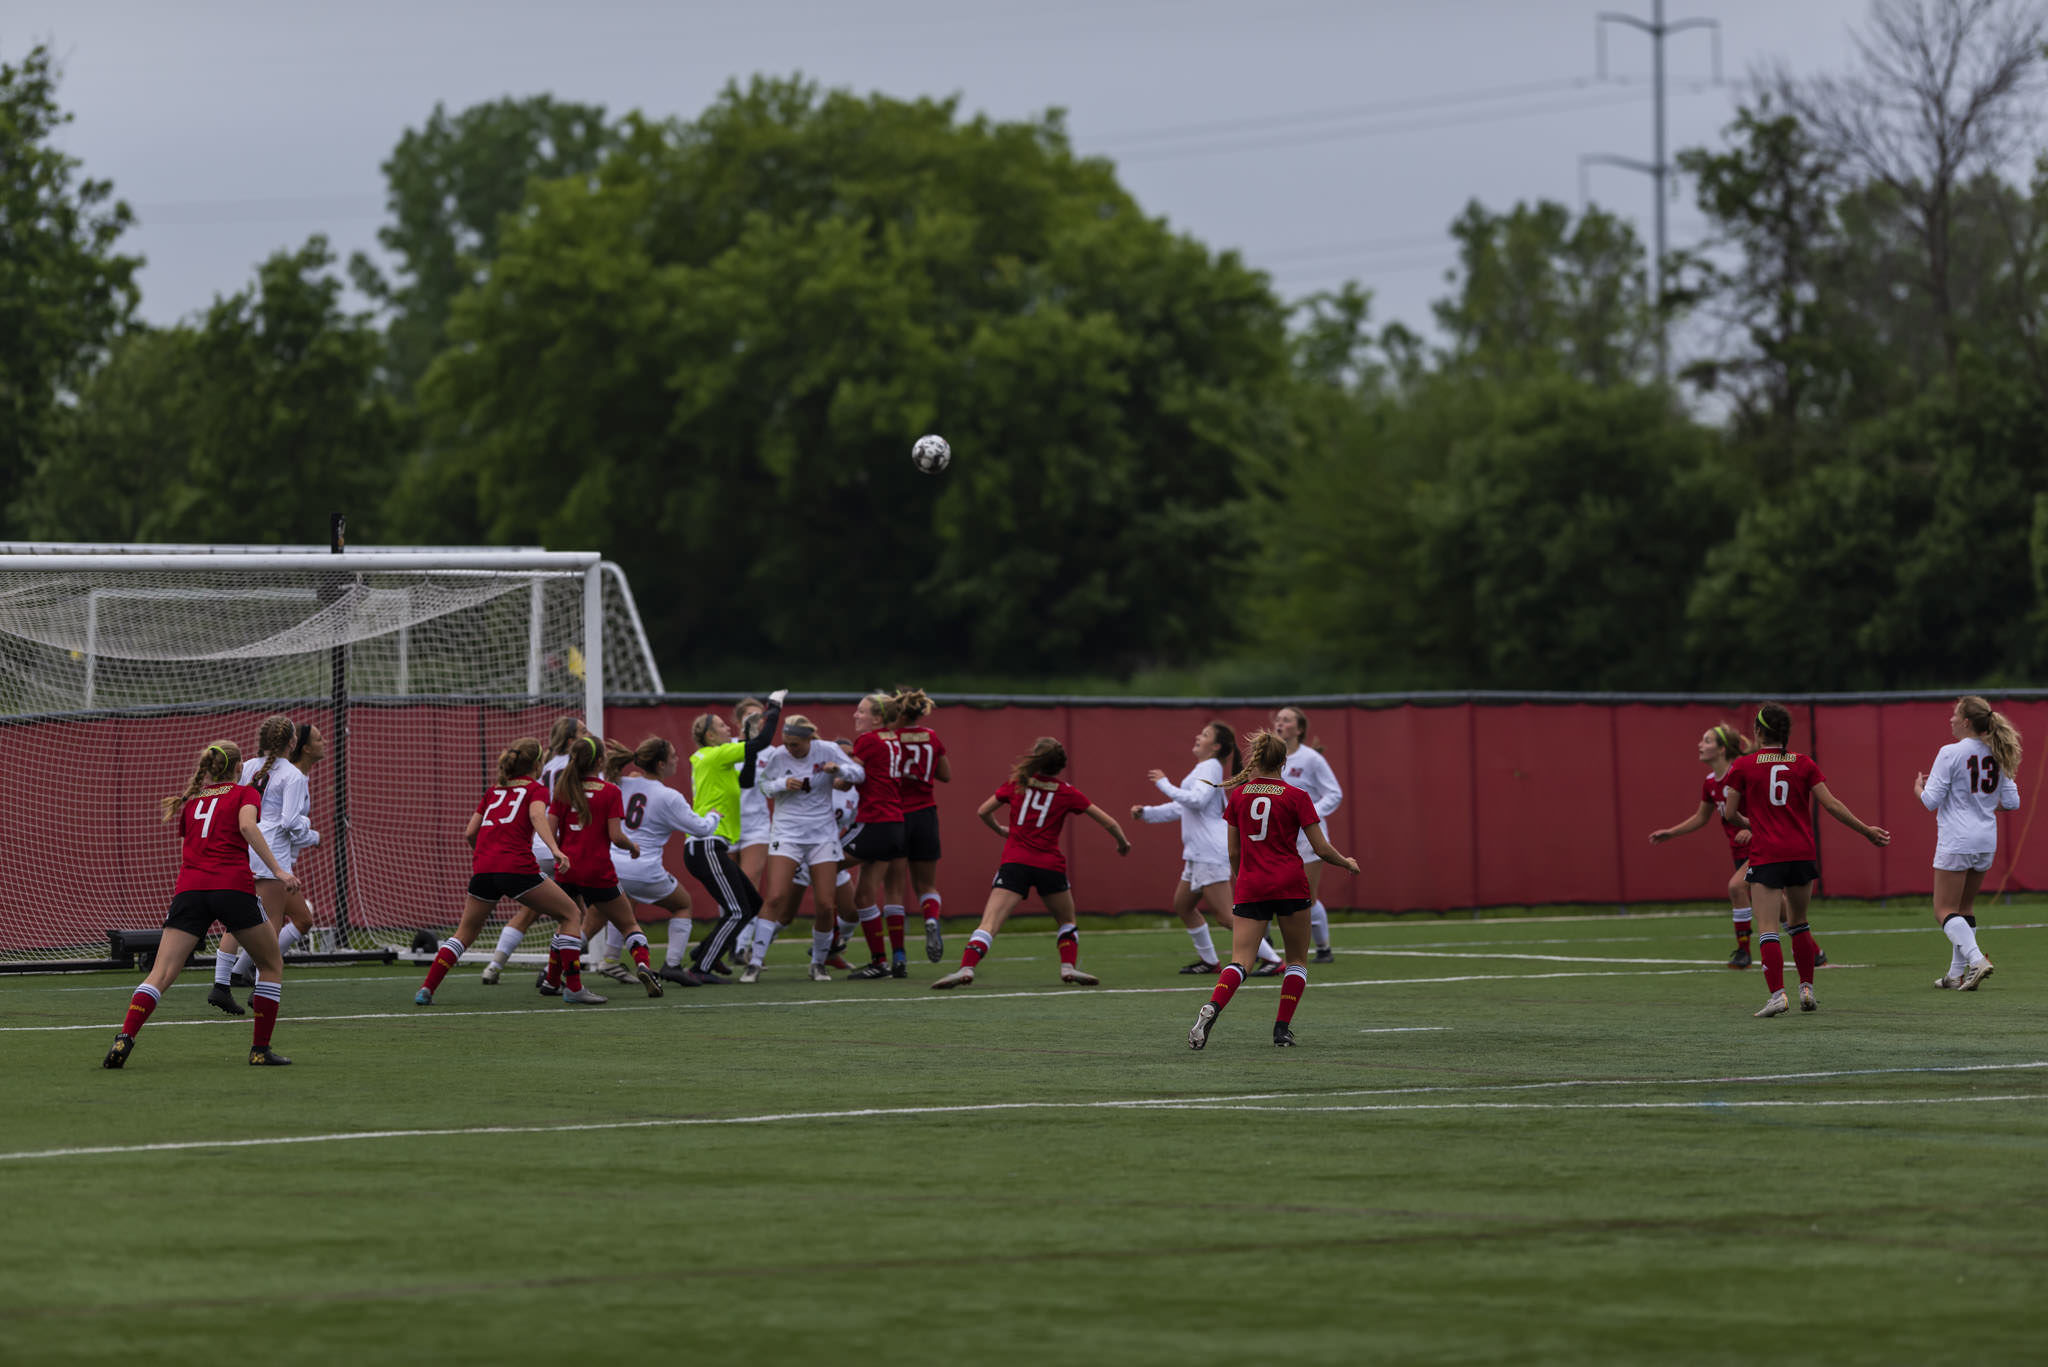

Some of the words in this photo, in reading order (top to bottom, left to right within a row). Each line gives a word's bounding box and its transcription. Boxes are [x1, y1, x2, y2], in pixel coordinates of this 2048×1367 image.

[903, 744, 934, 782] 21
[1967, 754, 2000, 794] 13
[1769, 764, 1791, 806] 6
[193, 797, 219, 838] 4
[481, 787, 527, 826] 23
[625, 793, 648, 830] 6
[1017, 788, 1055, 828] 14
[1248, 796, 1272, 842] 9
